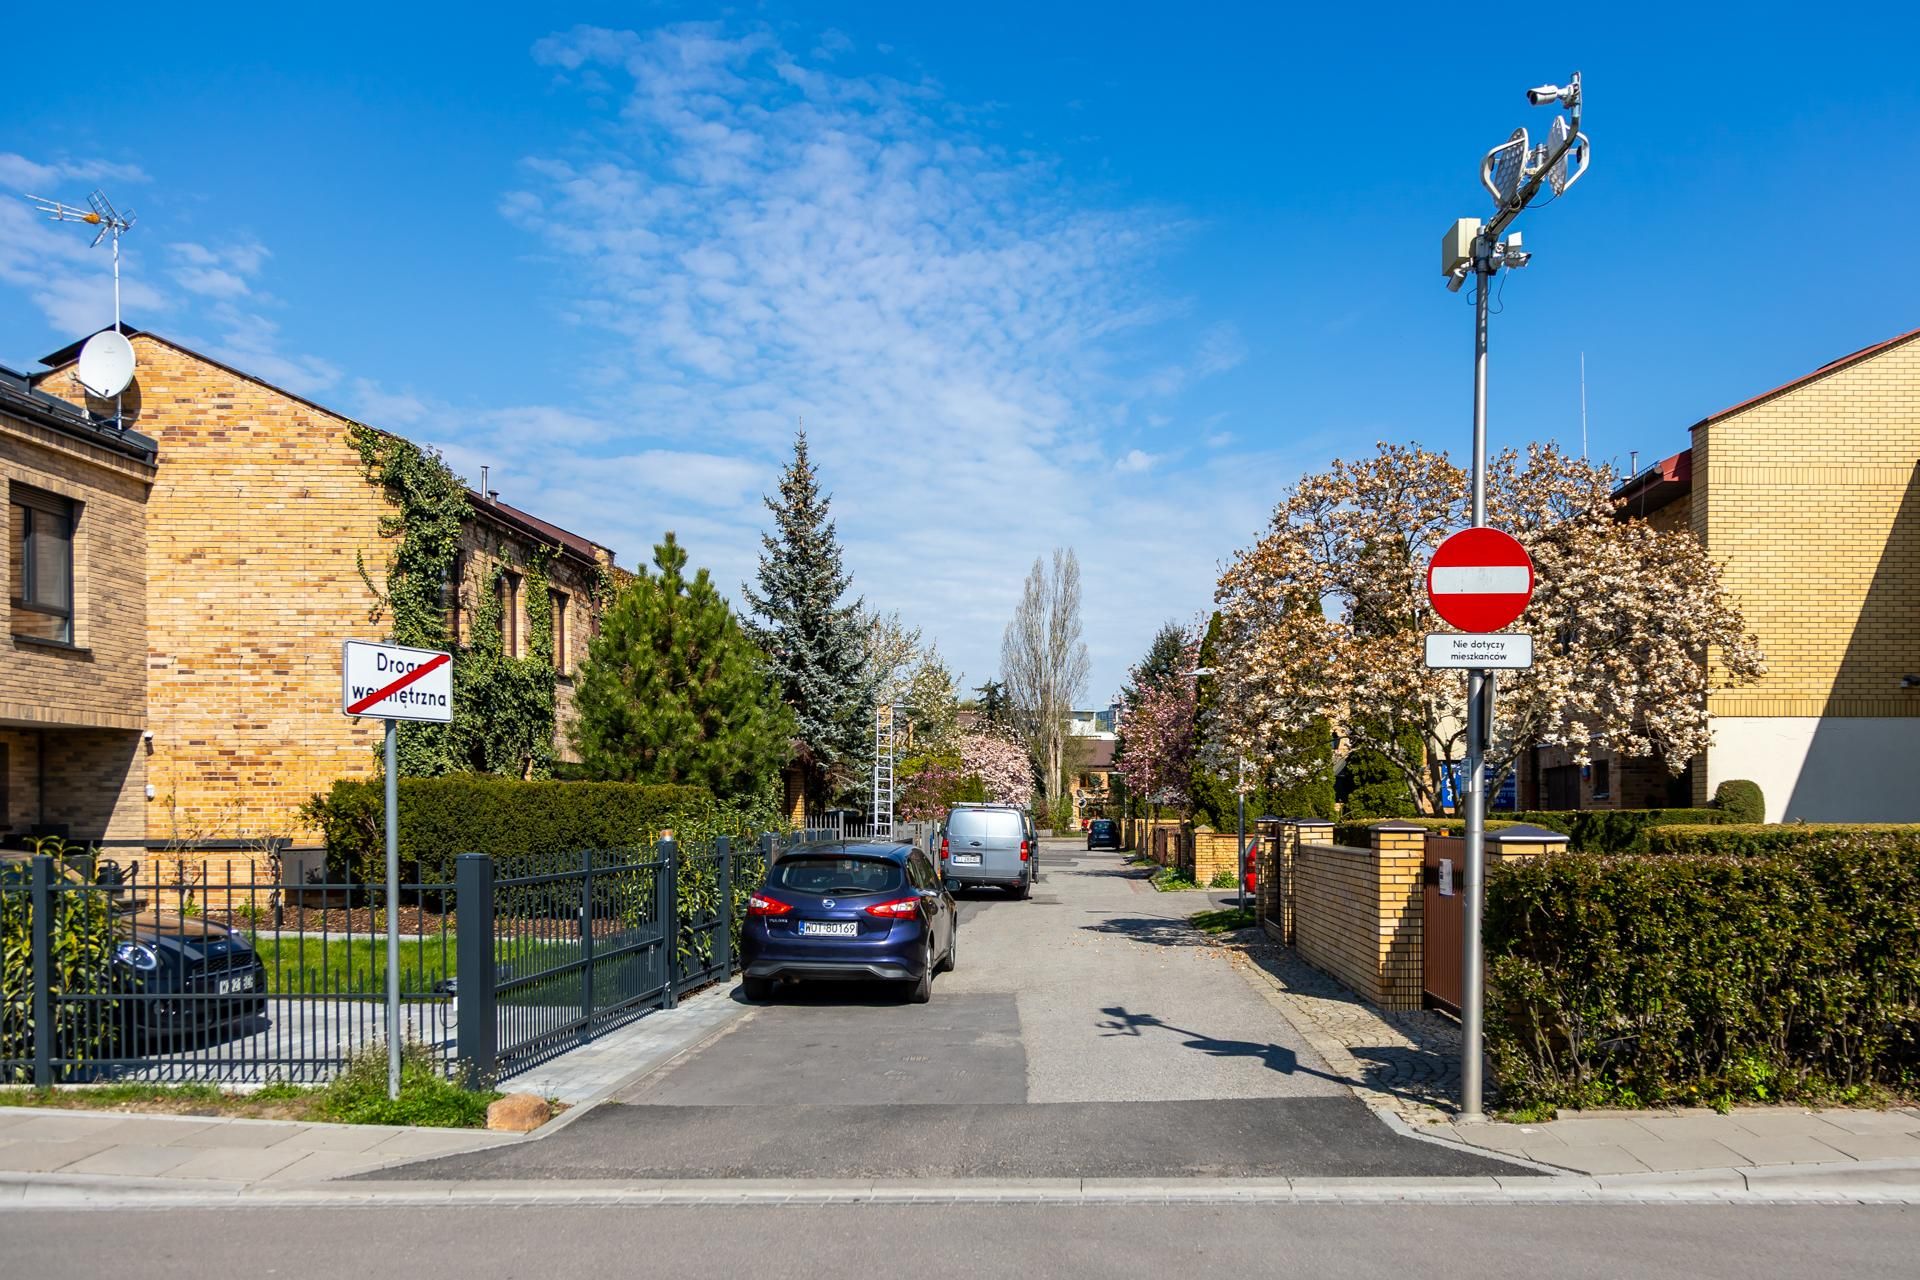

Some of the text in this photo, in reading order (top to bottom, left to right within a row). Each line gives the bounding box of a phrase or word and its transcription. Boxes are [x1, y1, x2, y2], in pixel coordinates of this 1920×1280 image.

[1453, 640, 1505, 650] Nie dotyczy
[1451, 652, 1507, 660] mieszkańców
[377, 652, 424, 675] Drog
